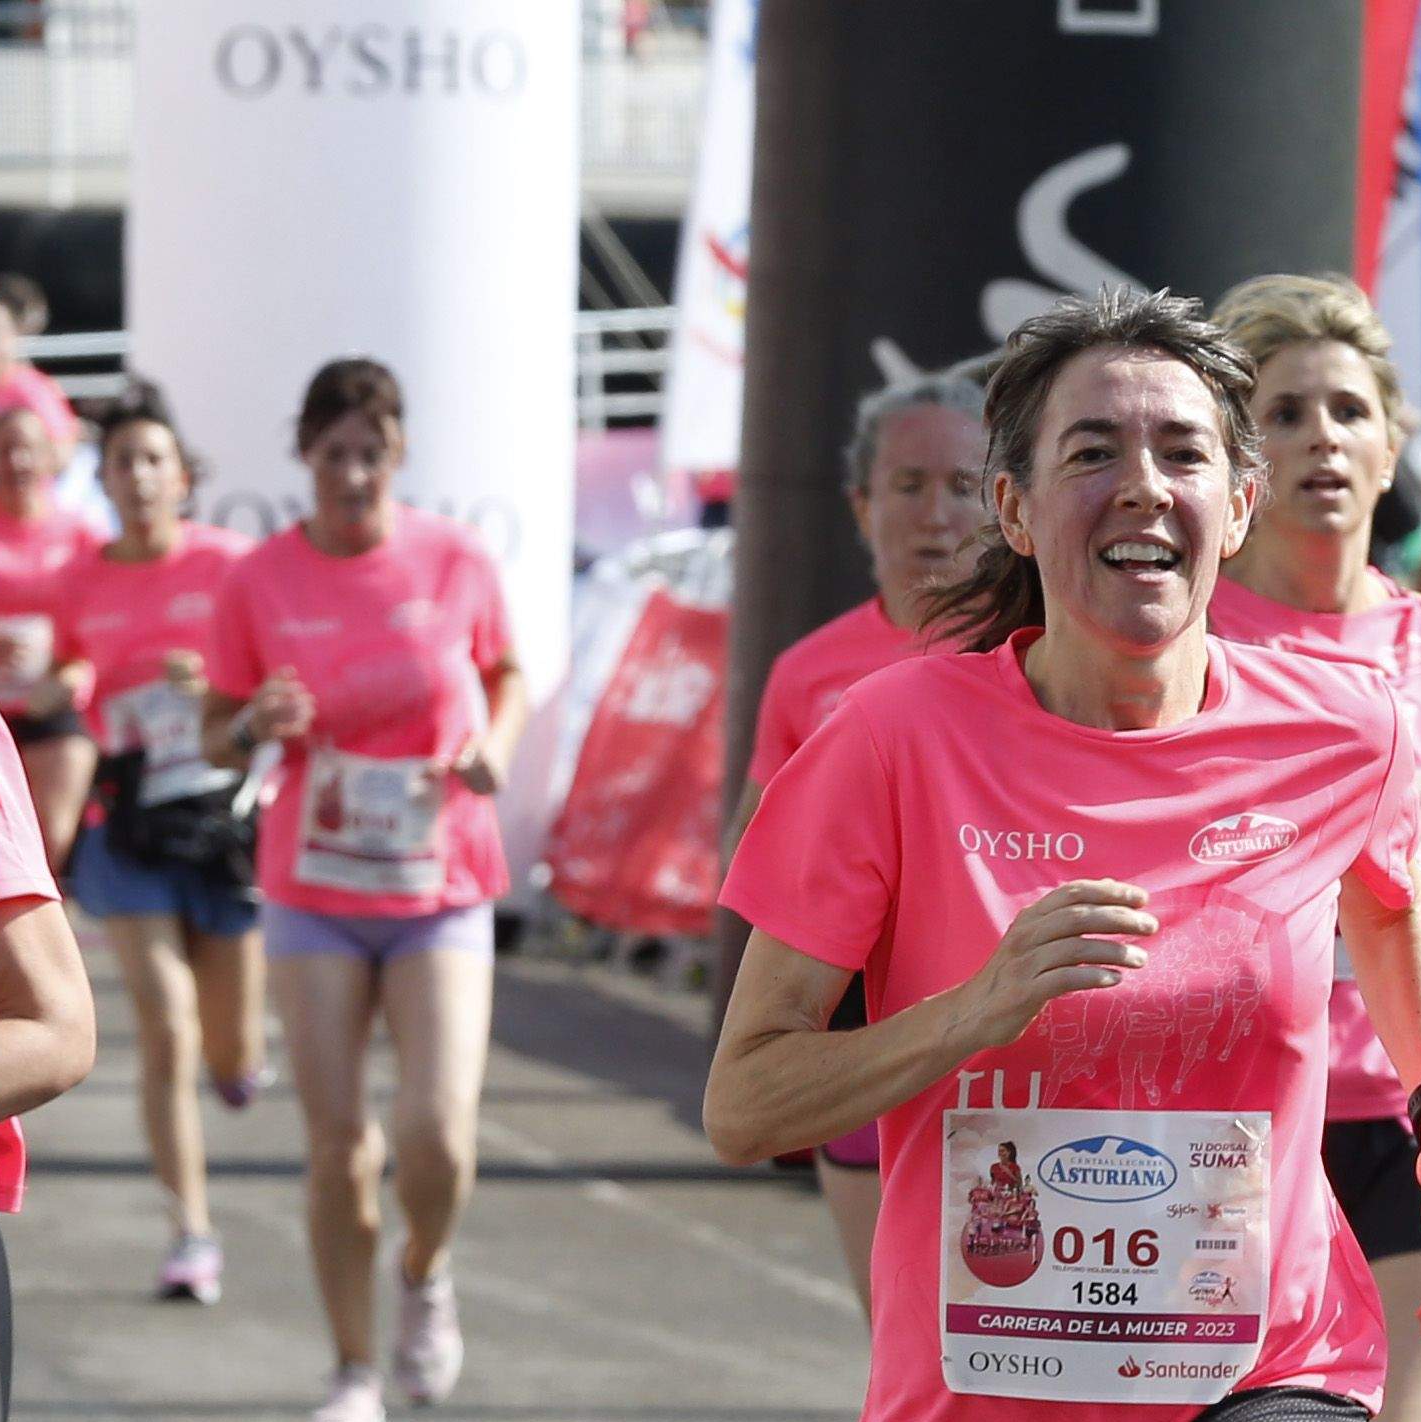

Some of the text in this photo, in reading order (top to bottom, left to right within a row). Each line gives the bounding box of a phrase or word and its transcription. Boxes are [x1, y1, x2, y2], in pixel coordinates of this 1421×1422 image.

[215, 24, 526, 97] OYSHO
[959, 823, 1084, 861] OYSHO
[1198, 835, 1291, 857] ASTURIANA
[1049, 1158, 1166, 1186] ASTURIANA
[1190, 1153, 1248, 1168] SUMA
[1053, 1226, 1160, 1267] 016
[1072, 1281, 1138, 1306] 1584
[978, 1314, 1236, 1337] CARRERA DE LA MUJER 2023
[969, 1351, 1240, 1379] OYSHO Santander
